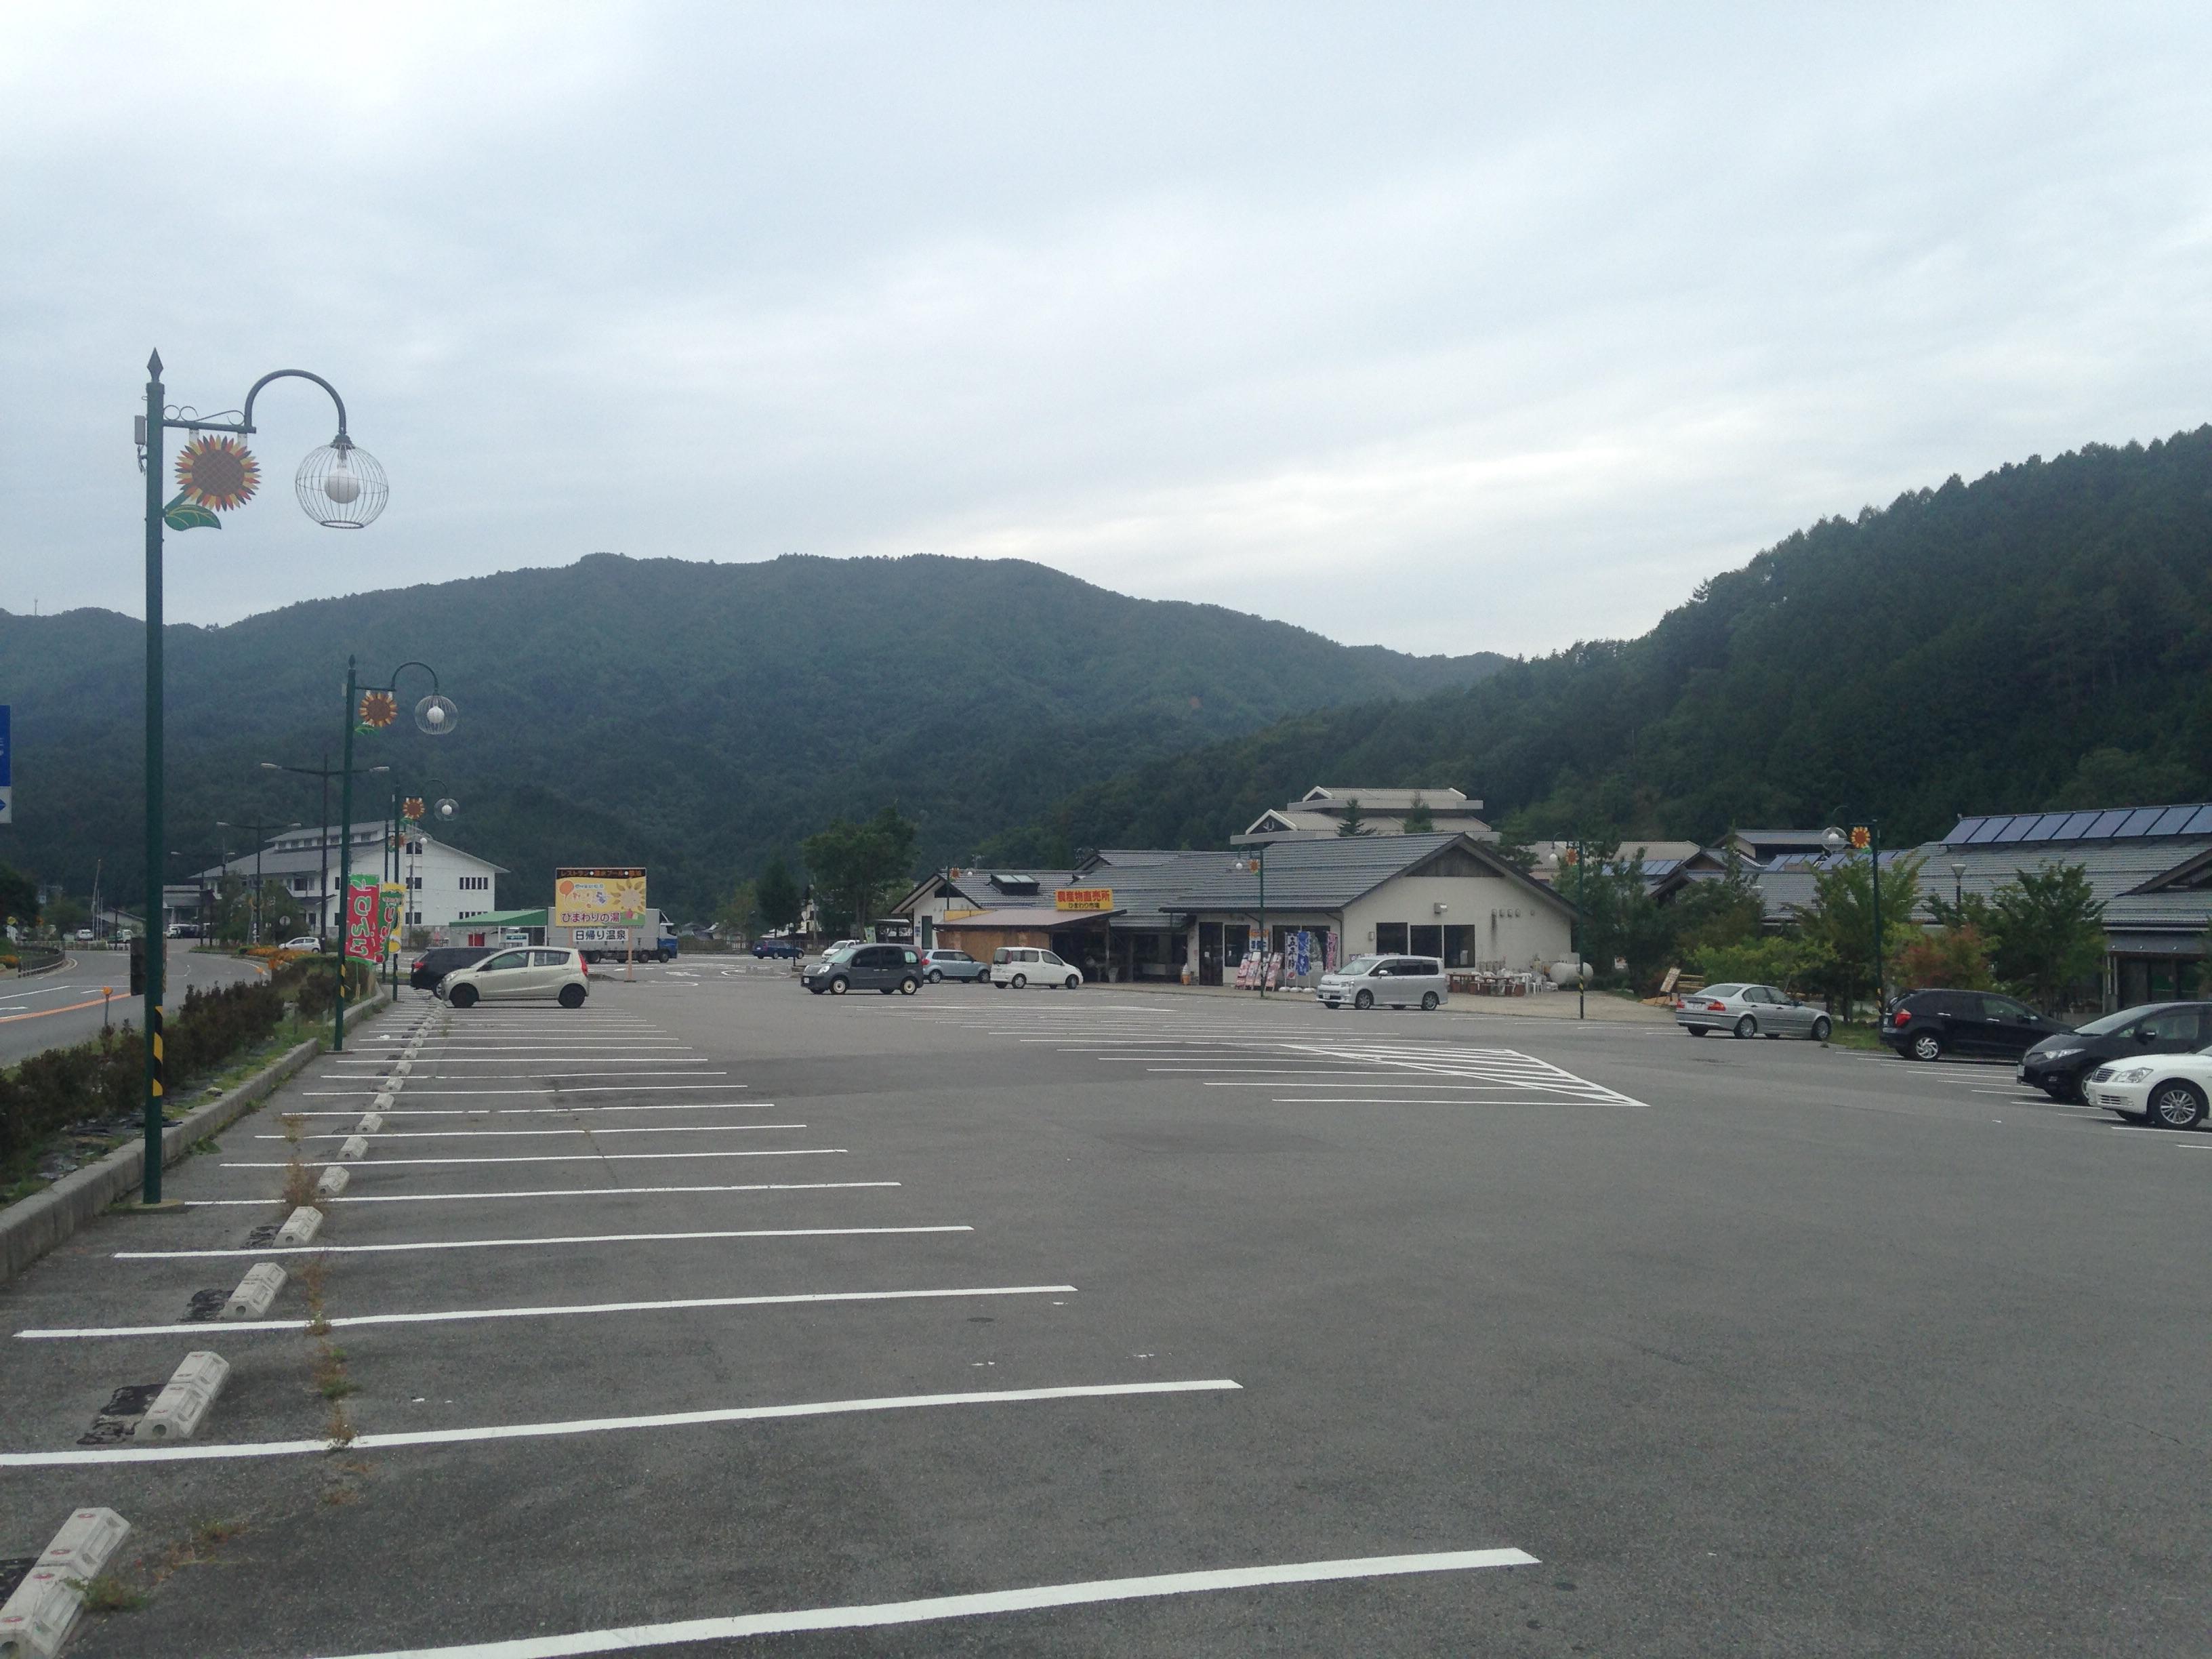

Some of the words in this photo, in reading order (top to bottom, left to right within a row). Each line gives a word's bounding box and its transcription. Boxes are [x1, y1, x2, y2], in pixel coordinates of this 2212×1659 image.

[1058, 890, 1109, 902] 農産物直売所
[562, 912, 620, 922] ひまわりの湯
[575, 930, 626, 940] 日帰り温泉
